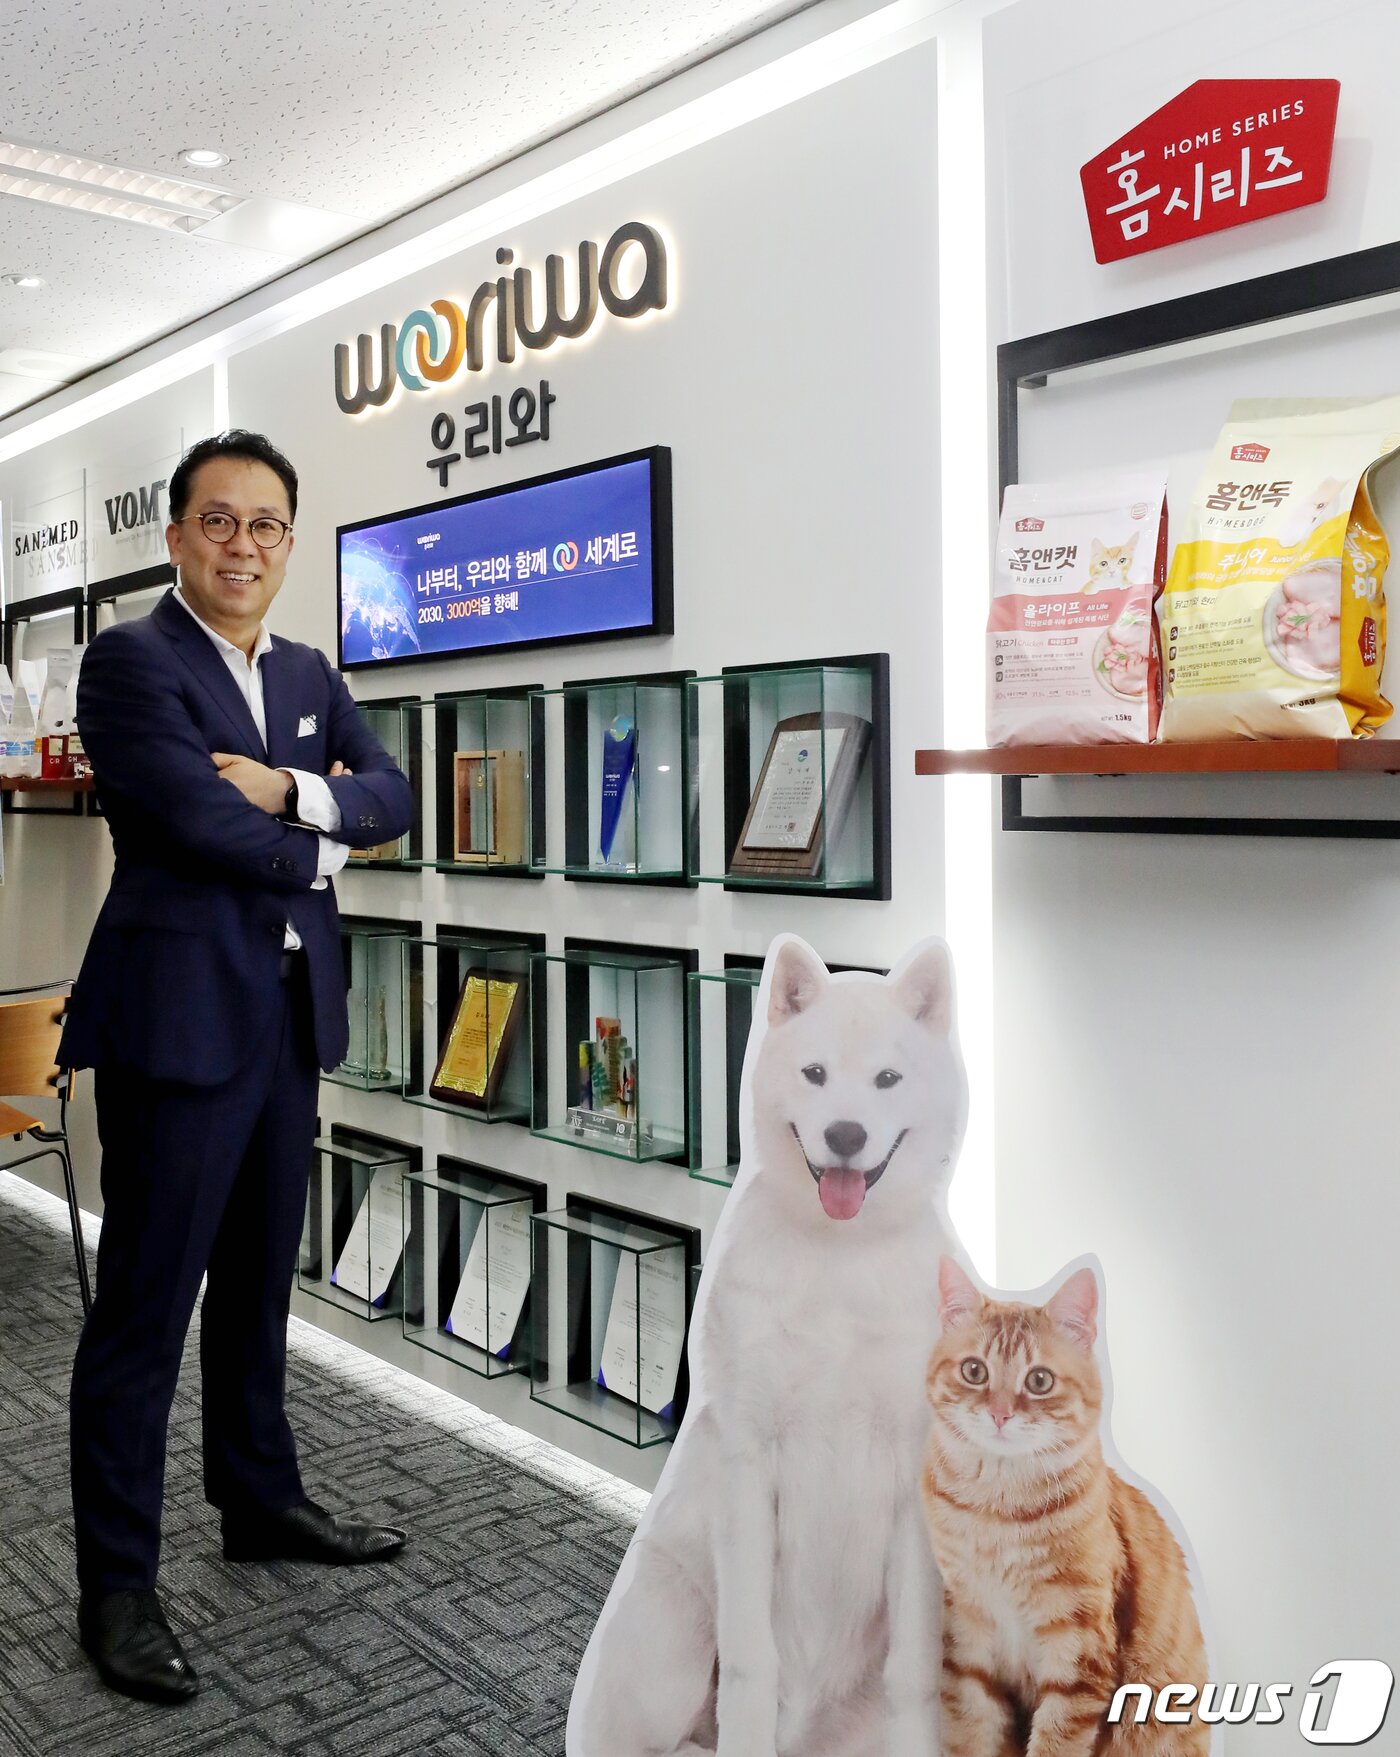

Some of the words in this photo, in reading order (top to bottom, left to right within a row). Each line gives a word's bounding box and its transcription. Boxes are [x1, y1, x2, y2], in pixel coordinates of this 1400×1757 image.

[1163, 127, 1222, 160] HOME
[1232, 100, 1305, 137] SERIES
[1105, 146, 1304, 241] 홈시리즈
[334, 221, 668, 415] wooriwa
[426, 379, 557, 488] 우리와
[1205, 480, 1294, 512] 홈앤독
[417, 563, 463, 597] 나부터,
[466, 557, 512, 585] 우리와
[515, 547, 547, 581] 함께
[584, 531, 639, 566] 세계로
[1008, 545, 1077, 572] 홈앤캣
[1217, 547, 1268, 571] 주니어
[1015, 575, 1064, 584] HOME&CAT
[418, 605, 444, 625] 2030,
[447, 595, 491, 619] 3000억을
[494, 591, 519, 615] 향해!
[1022, 601, 1081, 619] 올라이프
[995, 638, 1017, 648] 닭고기
